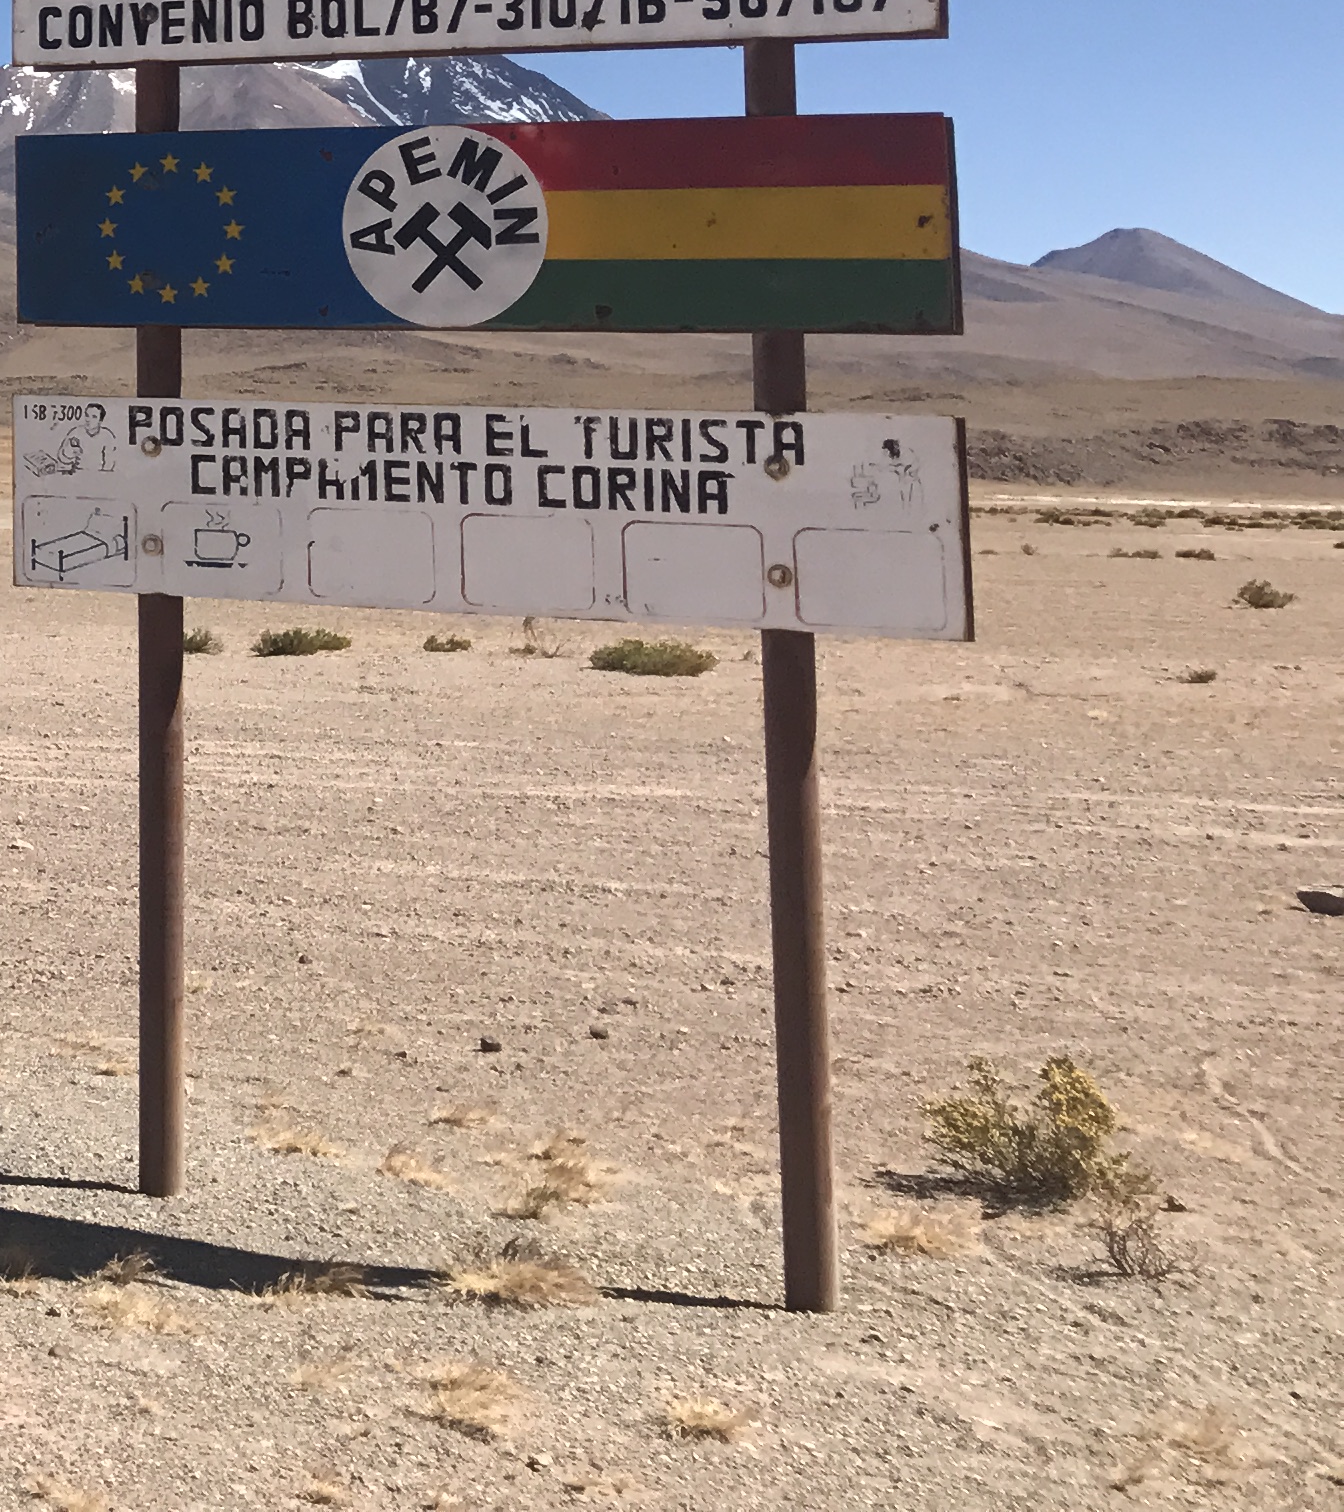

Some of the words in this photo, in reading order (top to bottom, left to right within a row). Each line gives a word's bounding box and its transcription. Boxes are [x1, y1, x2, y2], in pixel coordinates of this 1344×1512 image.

[349, 136, 540, 256] APEMIN
[128, 405, 311, 451] POSADA
[334, 410, 462, 455] PARA
[485, 413, 548, 458] EL
[574, 415, 805, 466] TURISTA
[537, 464, 736, 515] CORINA
